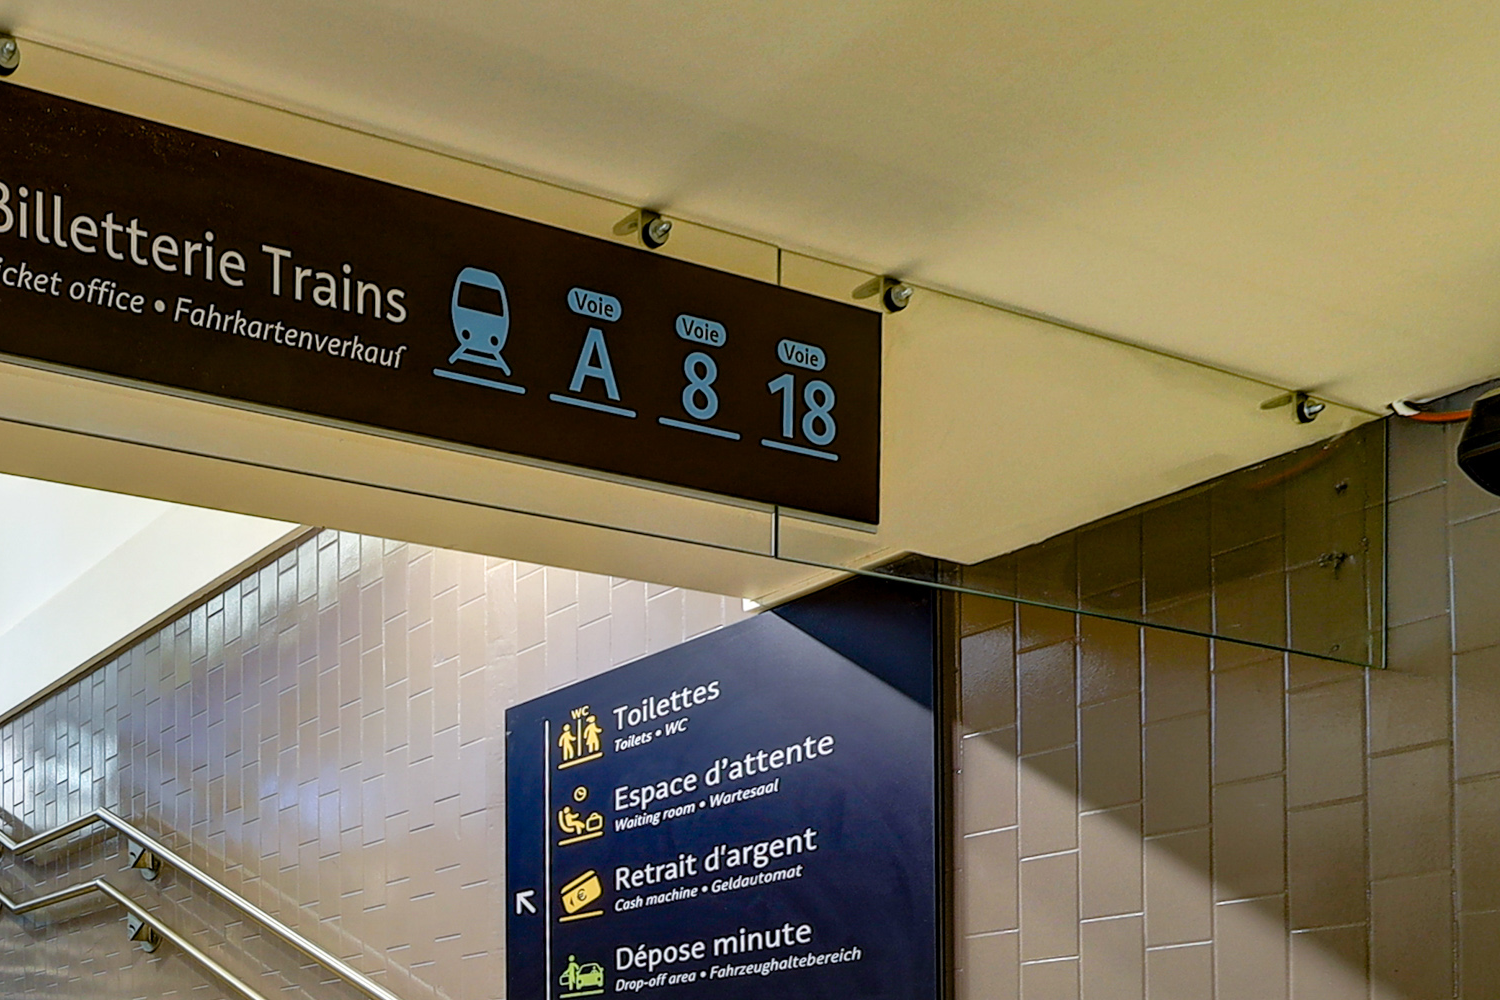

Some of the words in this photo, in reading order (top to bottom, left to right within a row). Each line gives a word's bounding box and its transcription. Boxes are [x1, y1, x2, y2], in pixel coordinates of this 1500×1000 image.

[262, 243, 408, 324] Trains
[574, 290, 615, 318] Voie
[69, 278, 146, 314] office
[173, 296, 407, 369] Fahrkartenverkauf
[681, 317, 720, 343] Voie
[569, 327, 621, 401] A
[782, 342, 819, 367] Voie
[682, 352, 719, 420] 8
[767, 373, 836, 446] 18
[571, 705, 590, 721] WC
[613, 680, 721, 730] Toilettes
[614, 731, 652, 752] Toilets
[665, 717, 689, 736] WC
[614, 773, 697, 811] Espace
[705, 734, 835, 787] d'attente
[614, 812, 661, 833] Waiting
[662, 802, 696, 821] room
[709, 778, 780, 809] Wartesaal
[615, 854, 698, 891] Retrait
[704, 827, 818, 872] d'argent
[615, 897, 644, 913] Cash
[645, 886, 698, 907] machine
[711, 864, 804, 894] Geldautomat
[615, 940, 706, 972] Dépose
[713, 922, 813, 956] minute
[615, 973, 667, 992] Drop-off
[668, 971, 697, 985] area
[709, 946, 863, 980] Fahrzeughaltebereich
